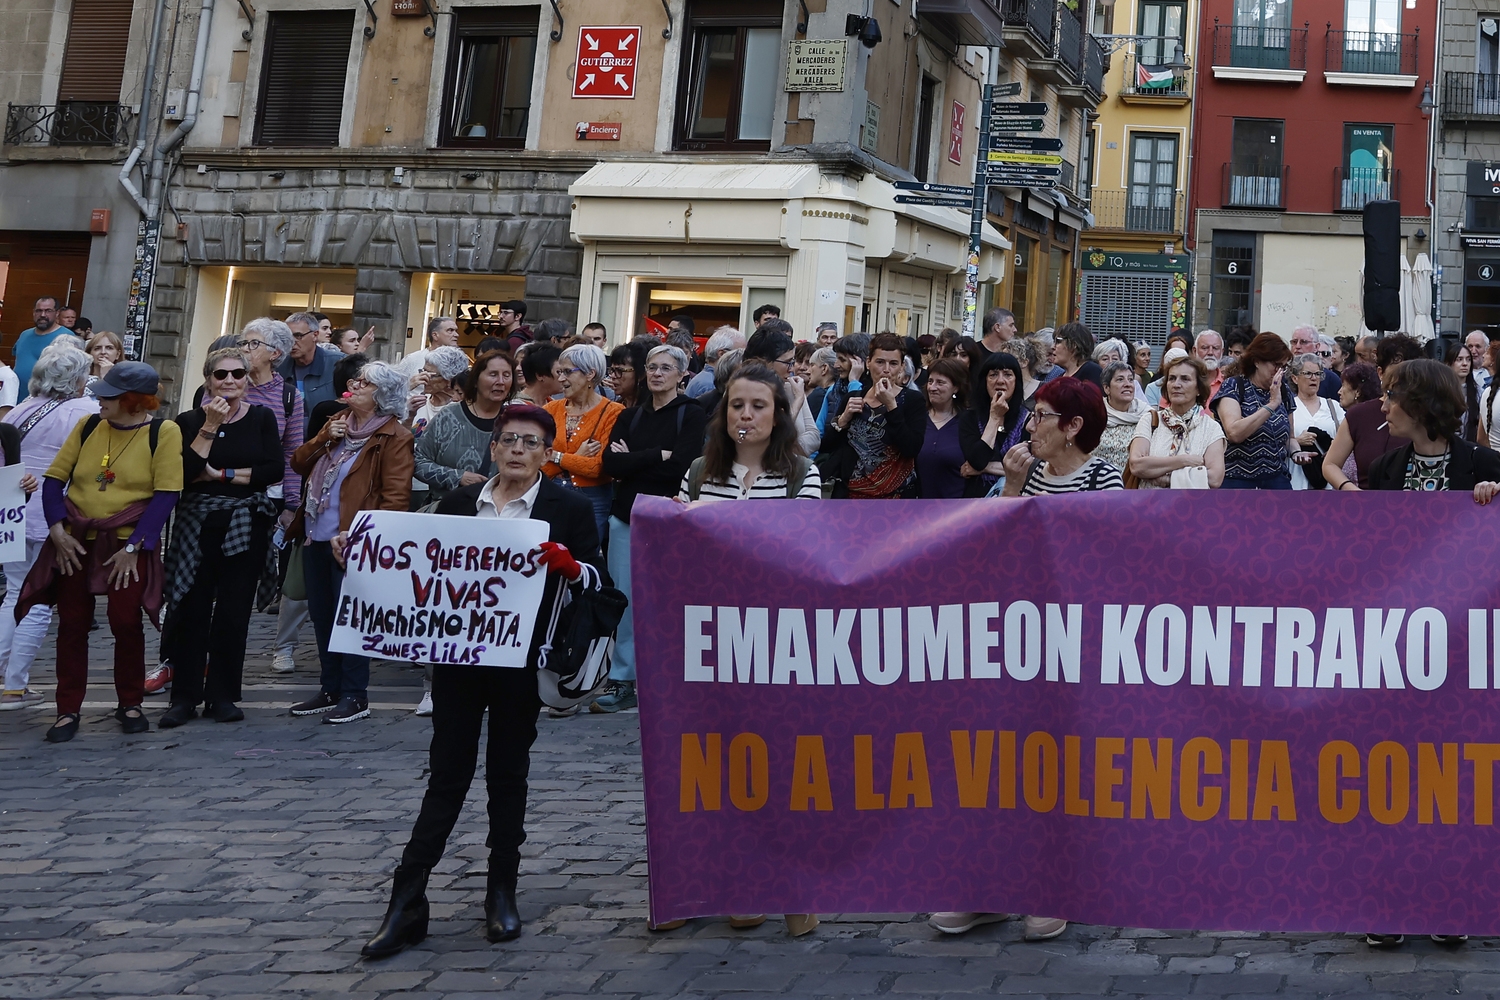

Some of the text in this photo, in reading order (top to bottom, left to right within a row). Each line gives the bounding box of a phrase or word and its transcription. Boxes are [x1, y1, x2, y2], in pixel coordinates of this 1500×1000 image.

[580, 58, 633, 66] GUTIERREZ
[797, 56, 836, 64] MERCADERES
[1109, 256, 1123, 267] TQ
[1228, 262, 1237, 274] 6
[1482, 267, 1490, 277] 4
[426, 538, 545, 578] QUEREMOS
[684, 600, 1082, 686] EMAKUMEON
[1100, 604, 1448, 690] KONTRAKO
[680, 732, 768, 812] NO
[790, 735, 833, 811] A
[854, 732, 932, 810] LA
[950, 730, 1297, 821] VIOLENCIA
